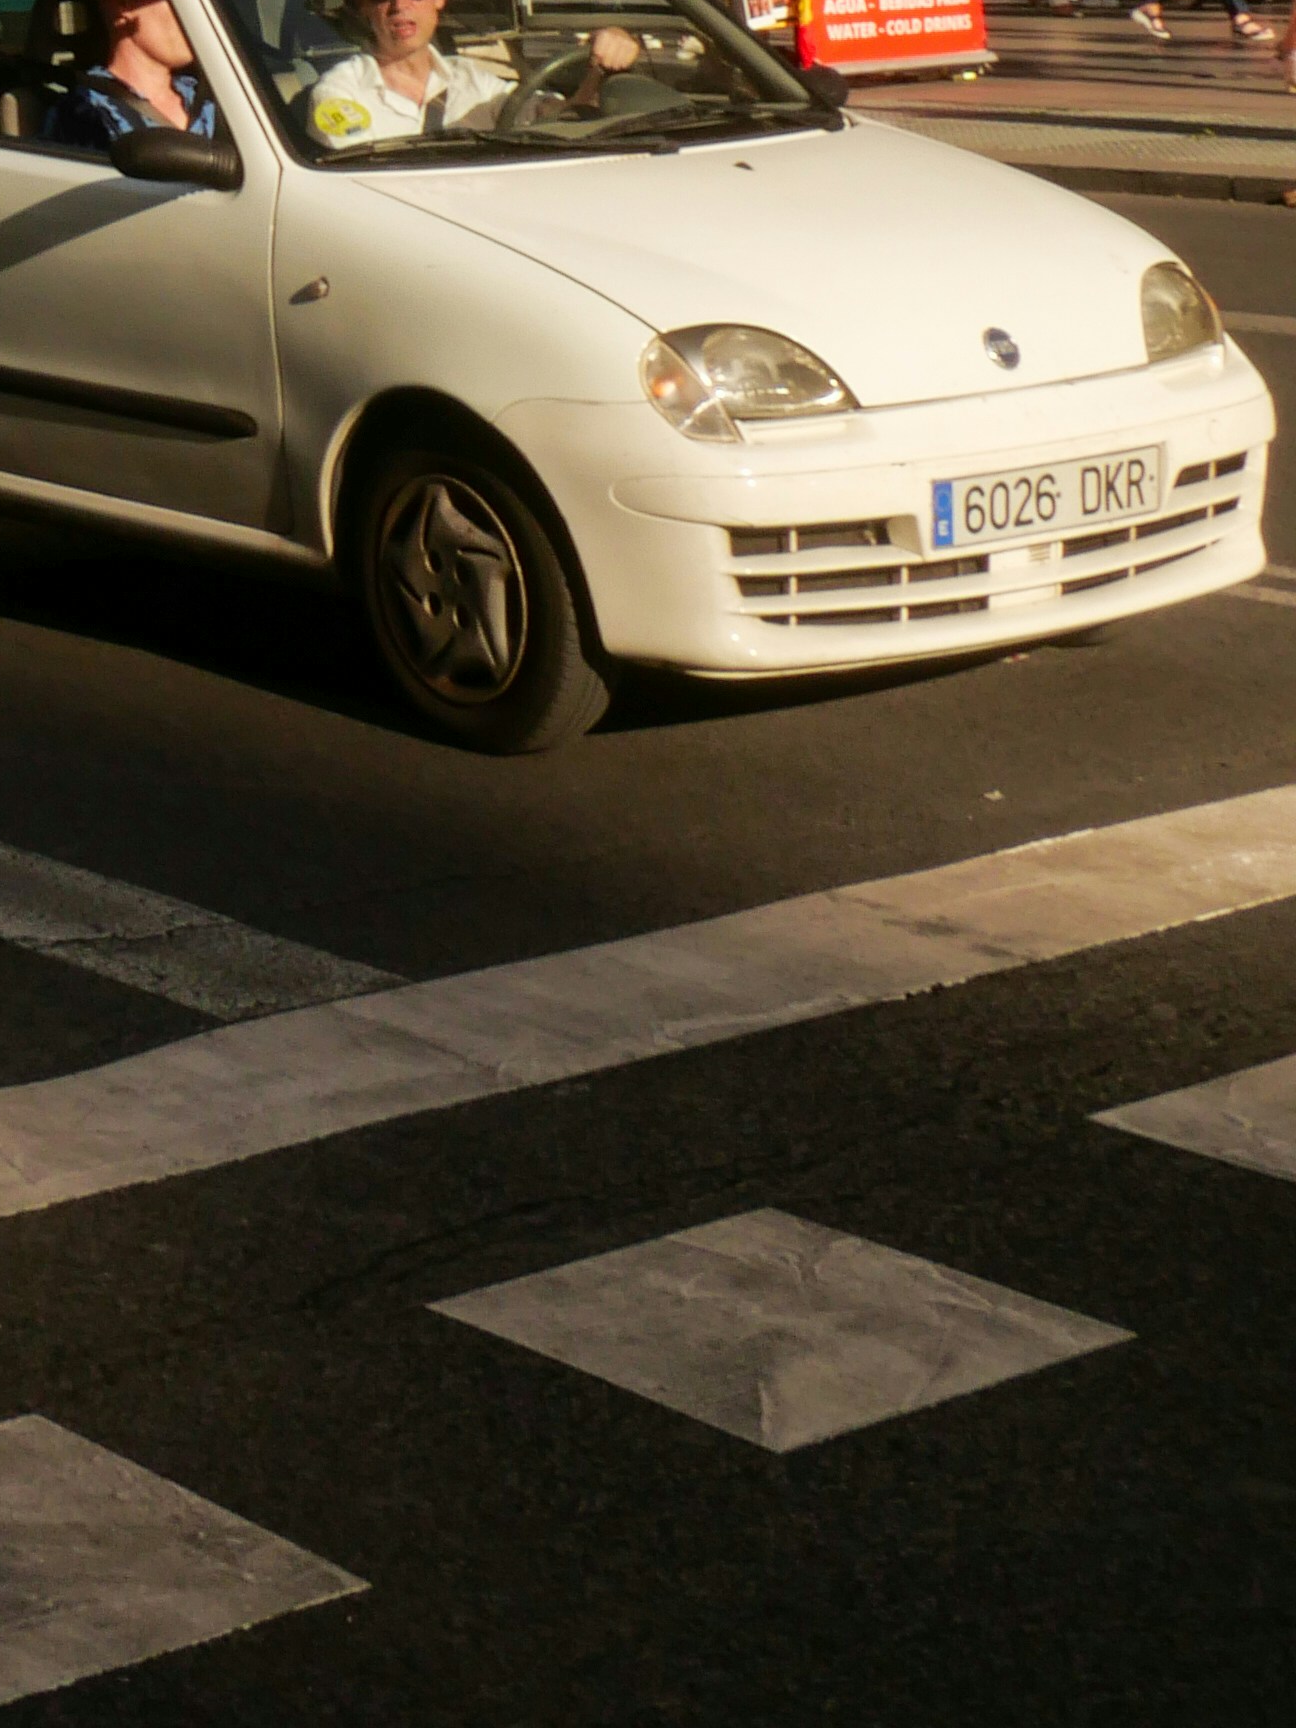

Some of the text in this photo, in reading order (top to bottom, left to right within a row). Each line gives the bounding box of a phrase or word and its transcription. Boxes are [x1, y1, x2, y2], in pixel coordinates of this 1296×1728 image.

[826, 22, 877, 41] WATER
[886, 18, 922, 36] COLD
[924, 13, 973, 33] DRINKS
[964, 458, 1146, 534] 6026 DKR
